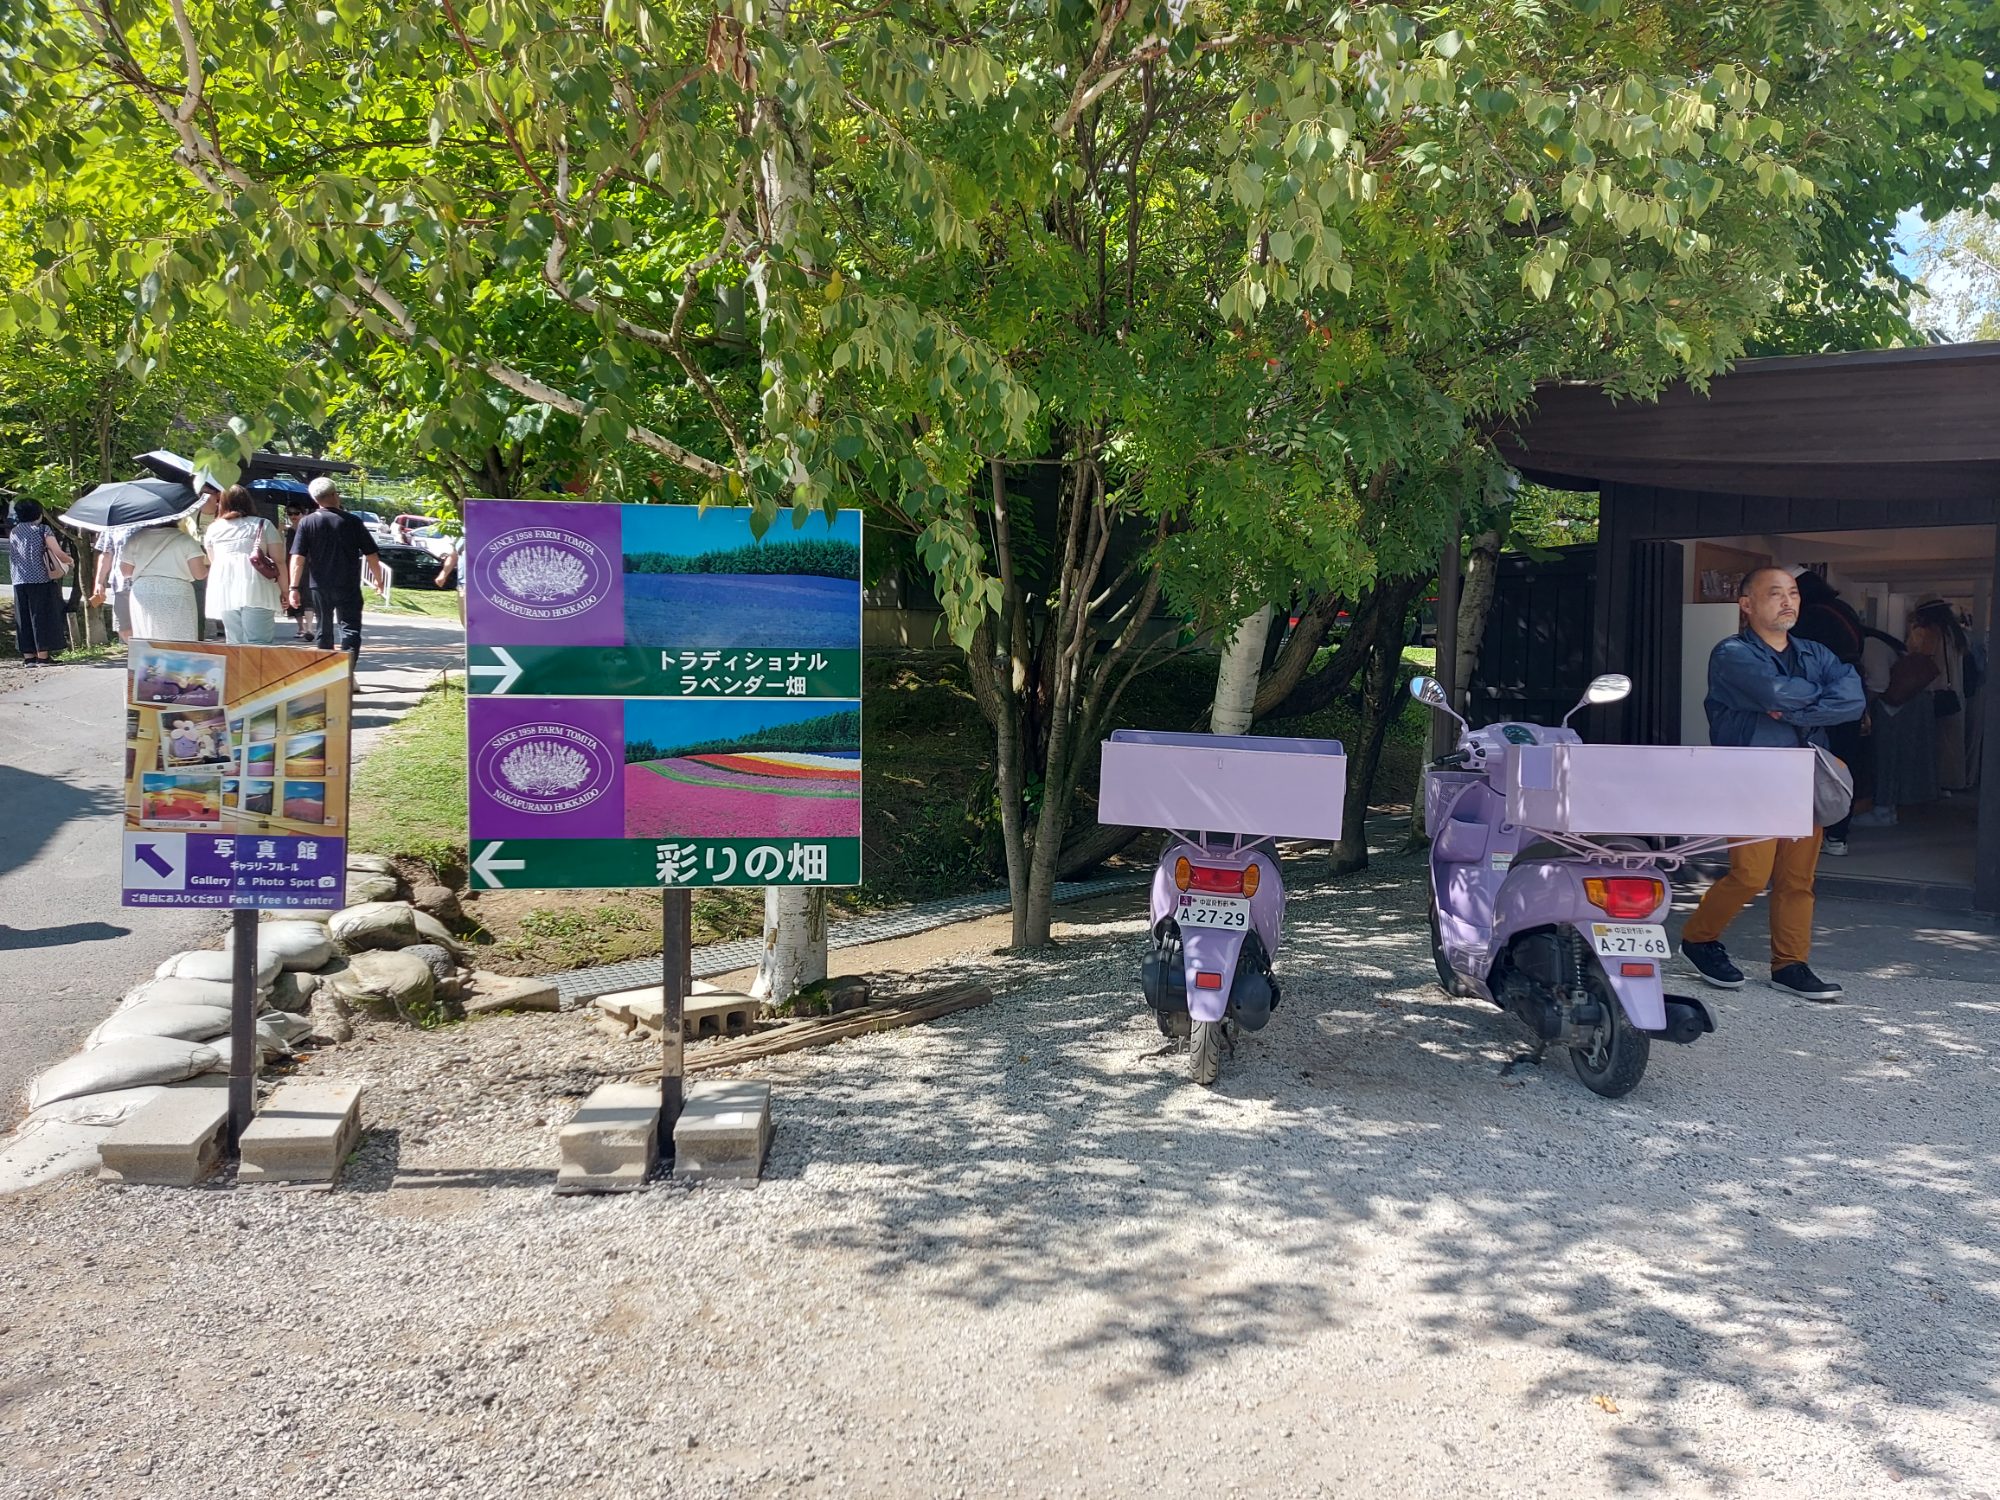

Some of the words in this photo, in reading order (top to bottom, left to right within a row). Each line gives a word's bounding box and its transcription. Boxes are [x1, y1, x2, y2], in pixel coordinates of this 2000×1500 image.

[490, 534, 515, 553] SINCE
[516, 531, 533, 541] 1958
[535, 530, 561, 540] FARM
[563, 534, 595, 556] TOMITA
[491, 594, 550, 618] NAKAFURANO
[552, 594, 597, 618] HOKKAIDO
[661, 650, 828, 672] トラディショナル
[680, 675, 807, 695] ラベンダー畑
[492, 731, 518, 749] SINCE
[519, 727, 536, 737] 1958
[538, 726, 563, 735] FARM
[566, 729, 597, 750] TOMITA
[493, 789, 552, 812] NAKAFURANO
[554, 788, 599, 812] HOKKAIDO
[213, 838, 318, 860] 写真館
[229, 861, 299, 872] ギャラリーフルール
[656, 842, 827, 884] 彩りの畑
[190, 876, 231, 887] Gallery
[237, 877, 246, 886] &
[252, 877, 285, 886] Photo
[290, 878, 315, 888] Spot
[131, 893, 223, 904] ご自由にお入りください
[228, 895, 254, 904] Feel
[258, 895, 281, 904] free
[286, 896, 299, 905] to
[303, 896, 334, 905] enter
[1181, 908, 1245, 926] A-27-29
[1601, 938, 1666, 953] A-27-68
